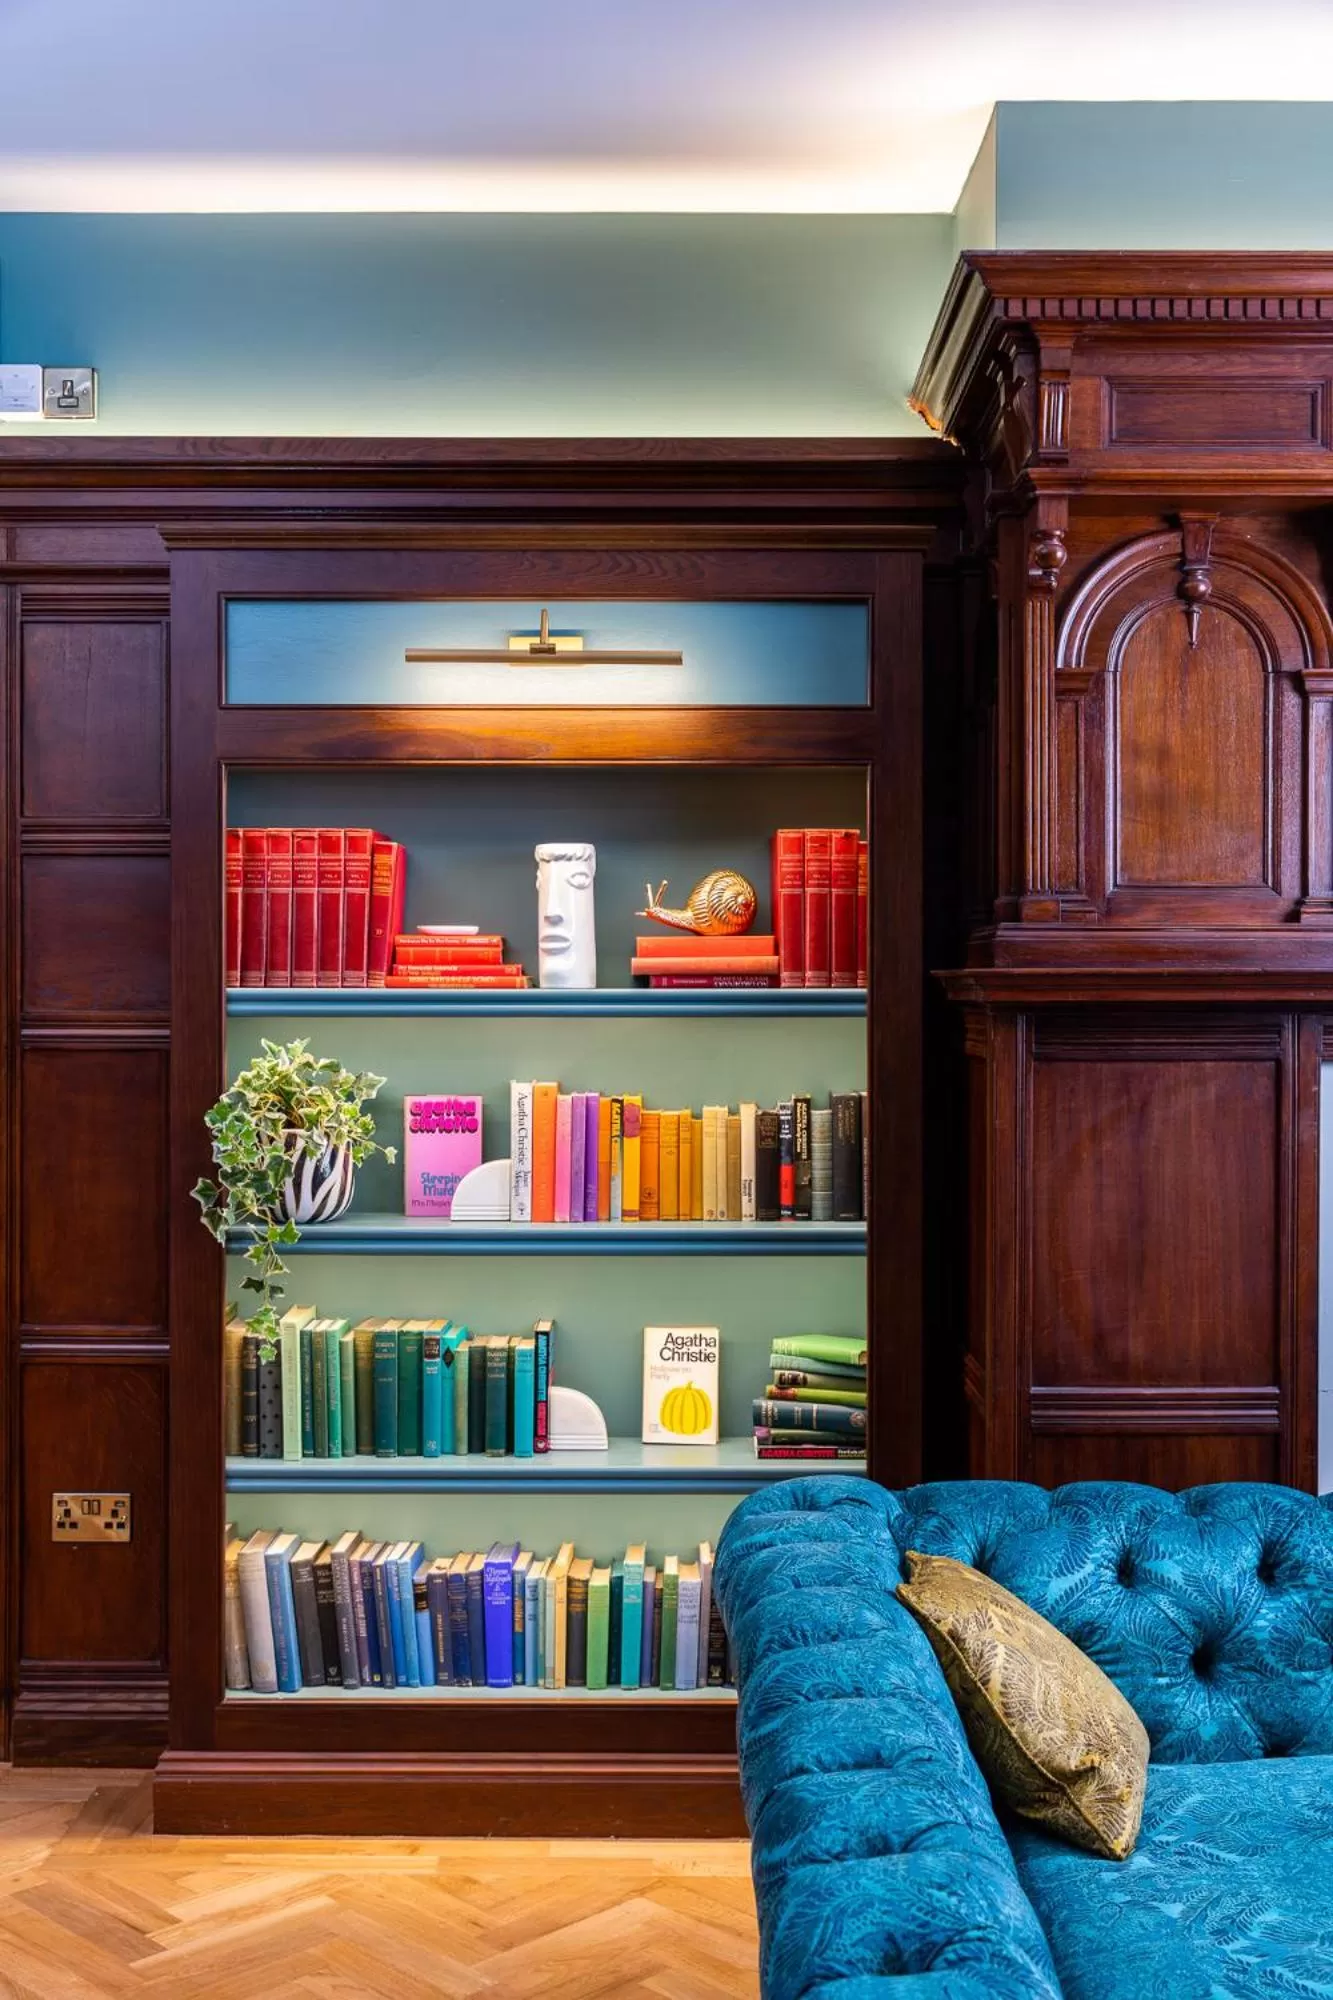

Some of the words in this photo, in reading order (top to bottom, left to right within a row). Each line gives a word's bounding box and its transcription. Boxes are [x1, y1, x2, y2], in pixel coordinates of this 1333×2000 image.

[410, 1098, 477, 1118] agatha
[517, 1092, 529, 1126] Agatha
[409, 1116, 479, 1135] christie
[517, 1127, 529, 1166] Christie
[423, 1184, 455, 1197] Murd
[664, 1332, 717, 1350] Agatha
[659, 1347, 717, 1363] Christie
